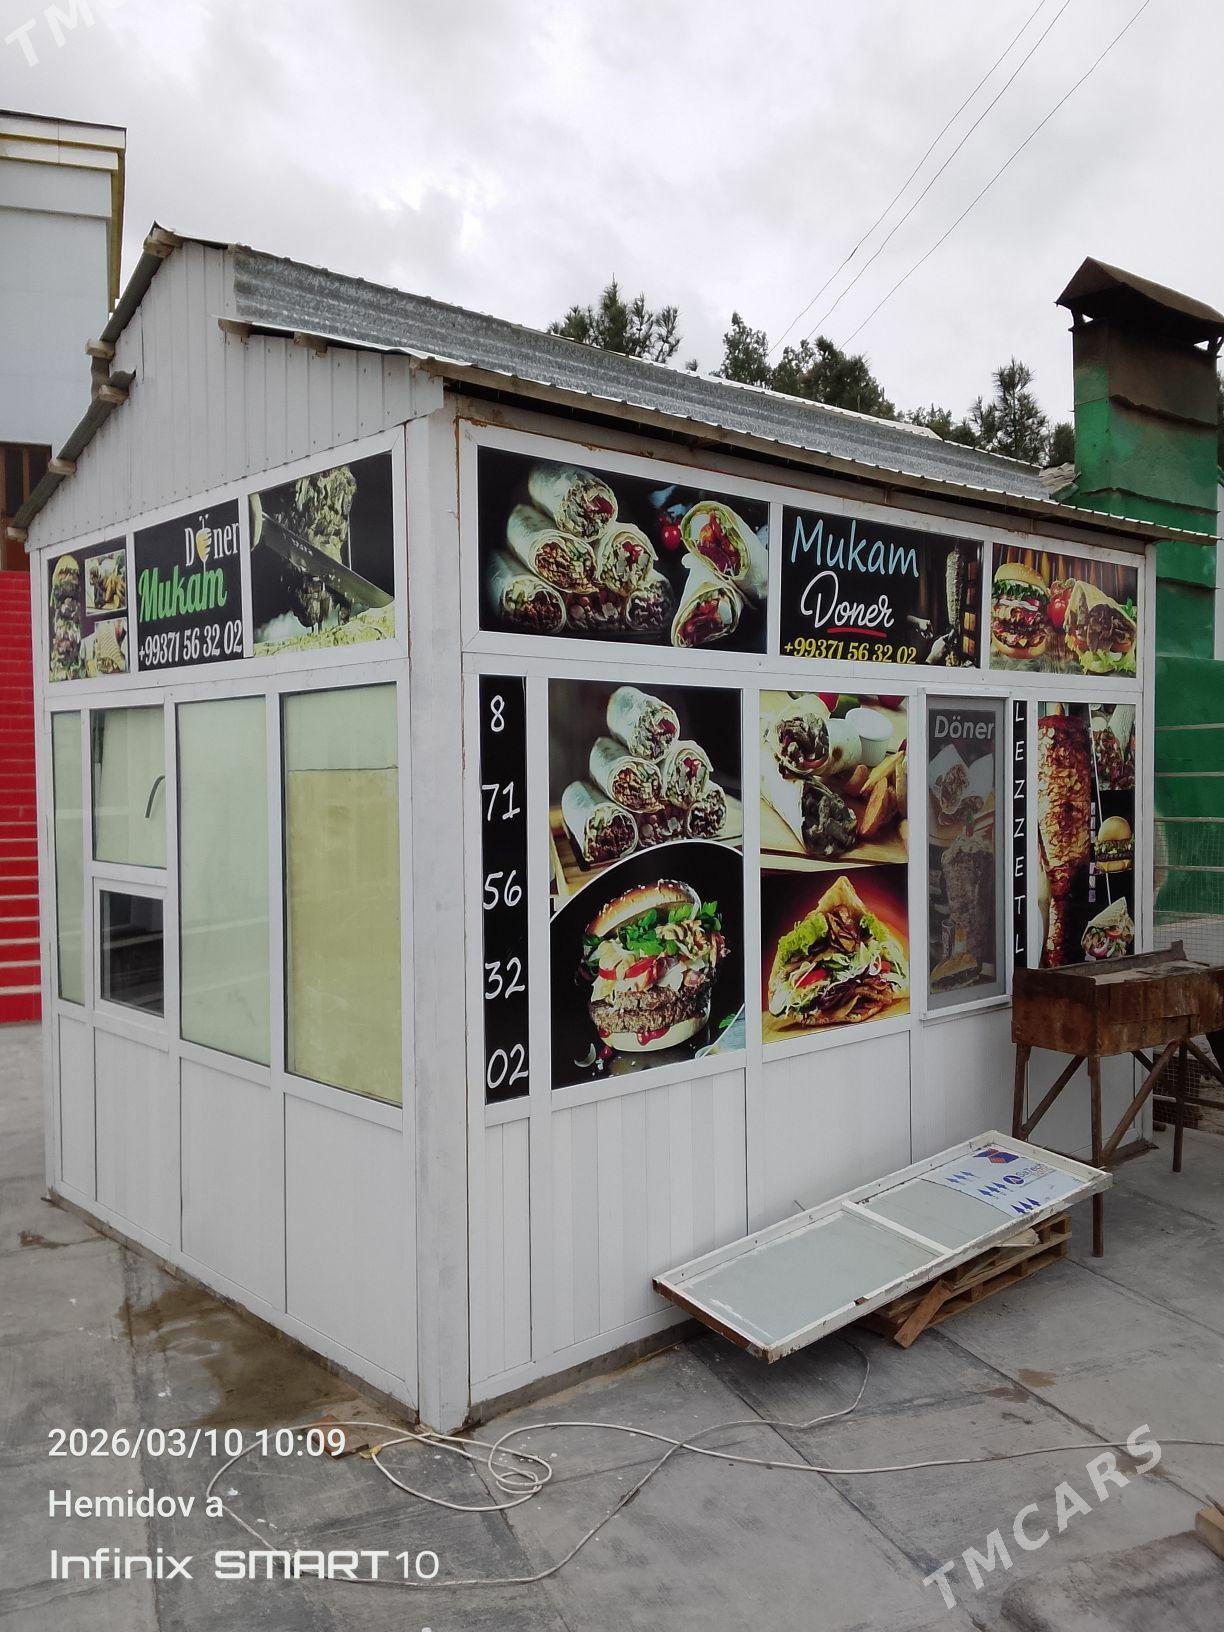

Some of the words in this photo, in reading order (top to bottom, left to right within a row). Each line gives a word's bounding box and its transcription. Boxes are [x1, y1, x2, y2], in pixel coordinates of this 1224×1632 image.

[791, 516, 919, 578] Mukam
[138, 565, 228, 623] Mukam
[800, 570, 894, 628] Doner
[138, 632, 180, 666] +99371
[183, 627, 200, 660] 56
[203, 623, 220, 657] 32
[223, 619, 243, 654] 02
[784, 637, 843, 660] +99371
[848, 641, 871, 662] 56
[873, 644, 893, 663] 32
[896, 645, 916, 664] 02
[490, 695, 505, 732] 8
[934, 714, 994, 740] Döner
[482, 781, 521, 821] 71
[483, 870, 522, 910] 56
[485, 957, 525, 1000] 32
[487, 1043, 528, 1089] 02
